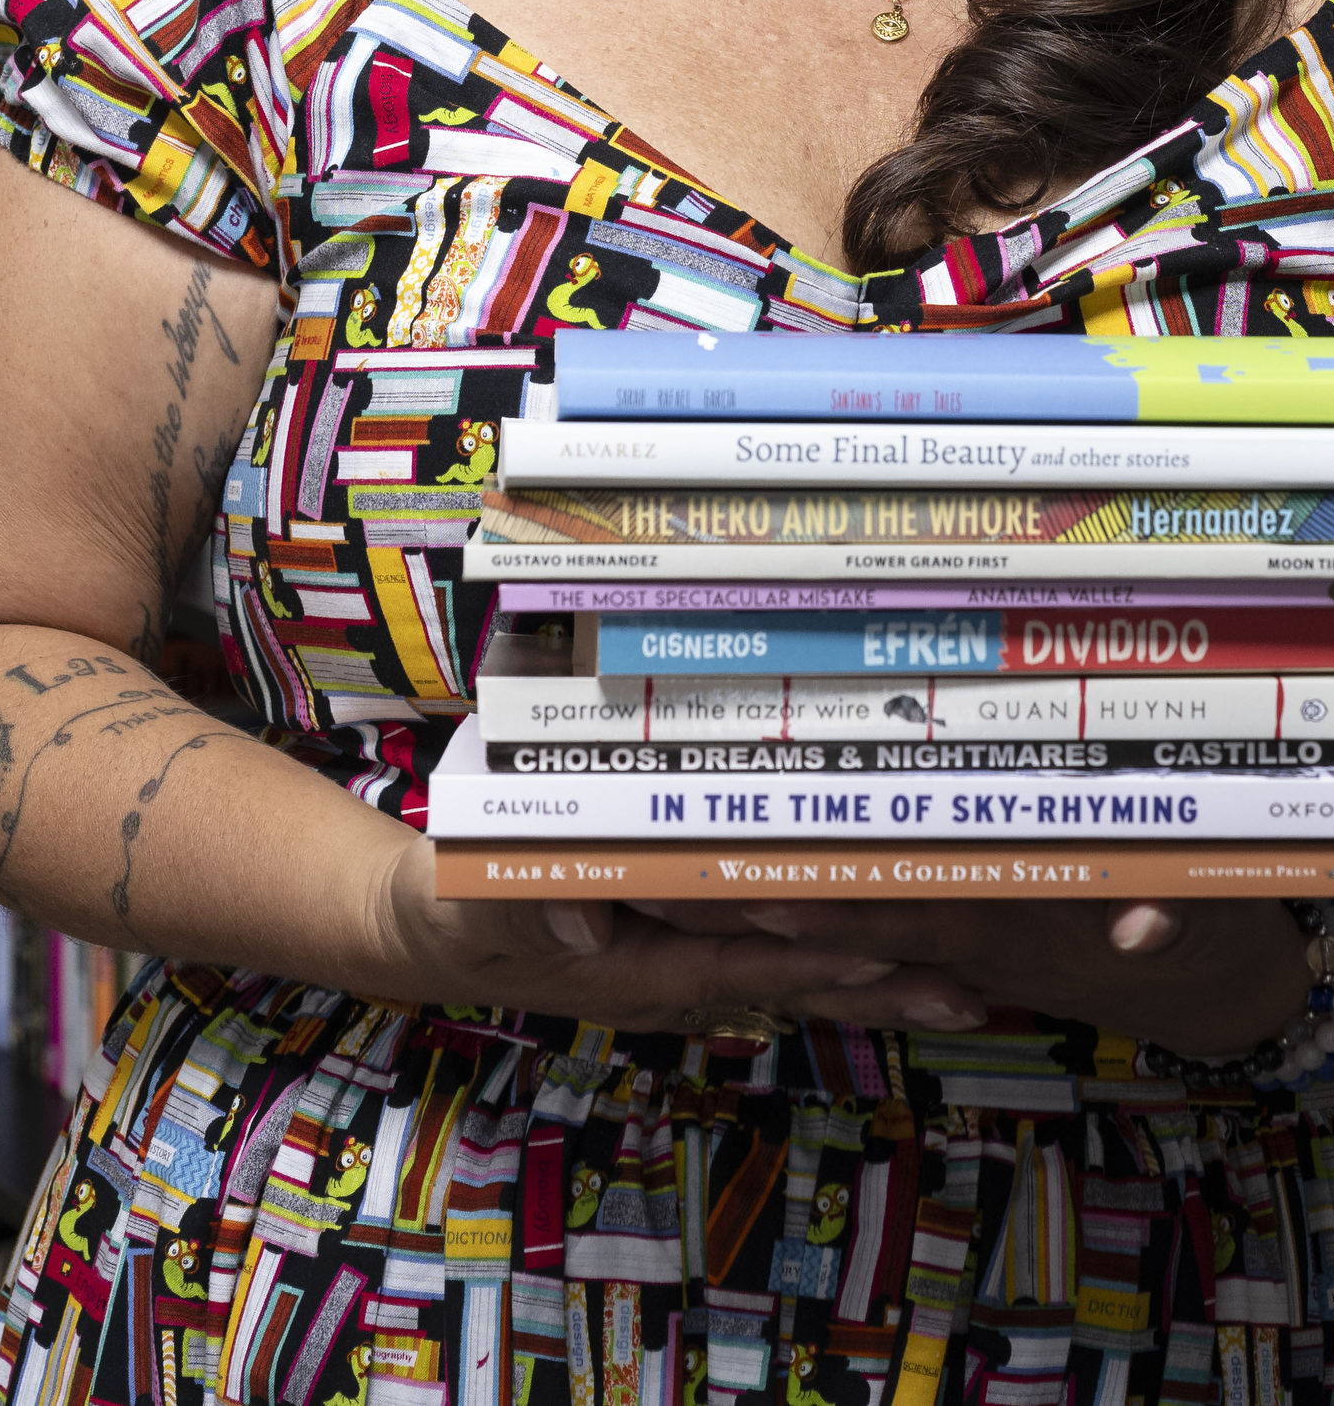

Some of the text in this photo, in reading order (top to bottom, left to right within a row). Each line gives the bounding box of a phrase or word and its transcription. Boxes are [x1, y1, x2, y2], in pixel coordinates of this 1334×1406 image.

[560, 435, 1190, 474] ALVAREZ Some Final Beauty and other stories
[619, 497, 1294, 537] THE HERO AND THE WHORE Hernandez
[491, 554, 562, 568] GUSTAVO
[566, 554, 658, 568] HERNANDEZ
[846, 556, 906, 569] FLOWER
[911, 556, 964, 569] GRAND
[968, 556, 1009, 570] FIRST
[1267, 557, 1315, 571] MOON
[550, 586, 1134, 608] THE MOST SPECTACULAR MISTAKE ANATALIA VALLEZ
[640, 614, 1209, 667] CISNEROS EFRÉN DIVIDIDO
[5, 656, 128, 695] Las
[530, 697, 1208, 728] sparrow in the razor wire QUAN HUYNH
[513, 741, 1323, 773] CHOLOS: DREAMS & NIGHTMARES CASTILLO
[483, 800, 579, 816] CALVILLO
[650, 793, 685, 822] IN
[704, 793, 770, 822] THE
[788, 794, 870, 822] TIME
[890, 794, 932, 823] OF
[951, 794, 1198, 825] SKY-RHYMING
[549, 862, 567, 880] &
[531, 1159, 551, 1234] biology
[572, 1311, 584, 1368] design
